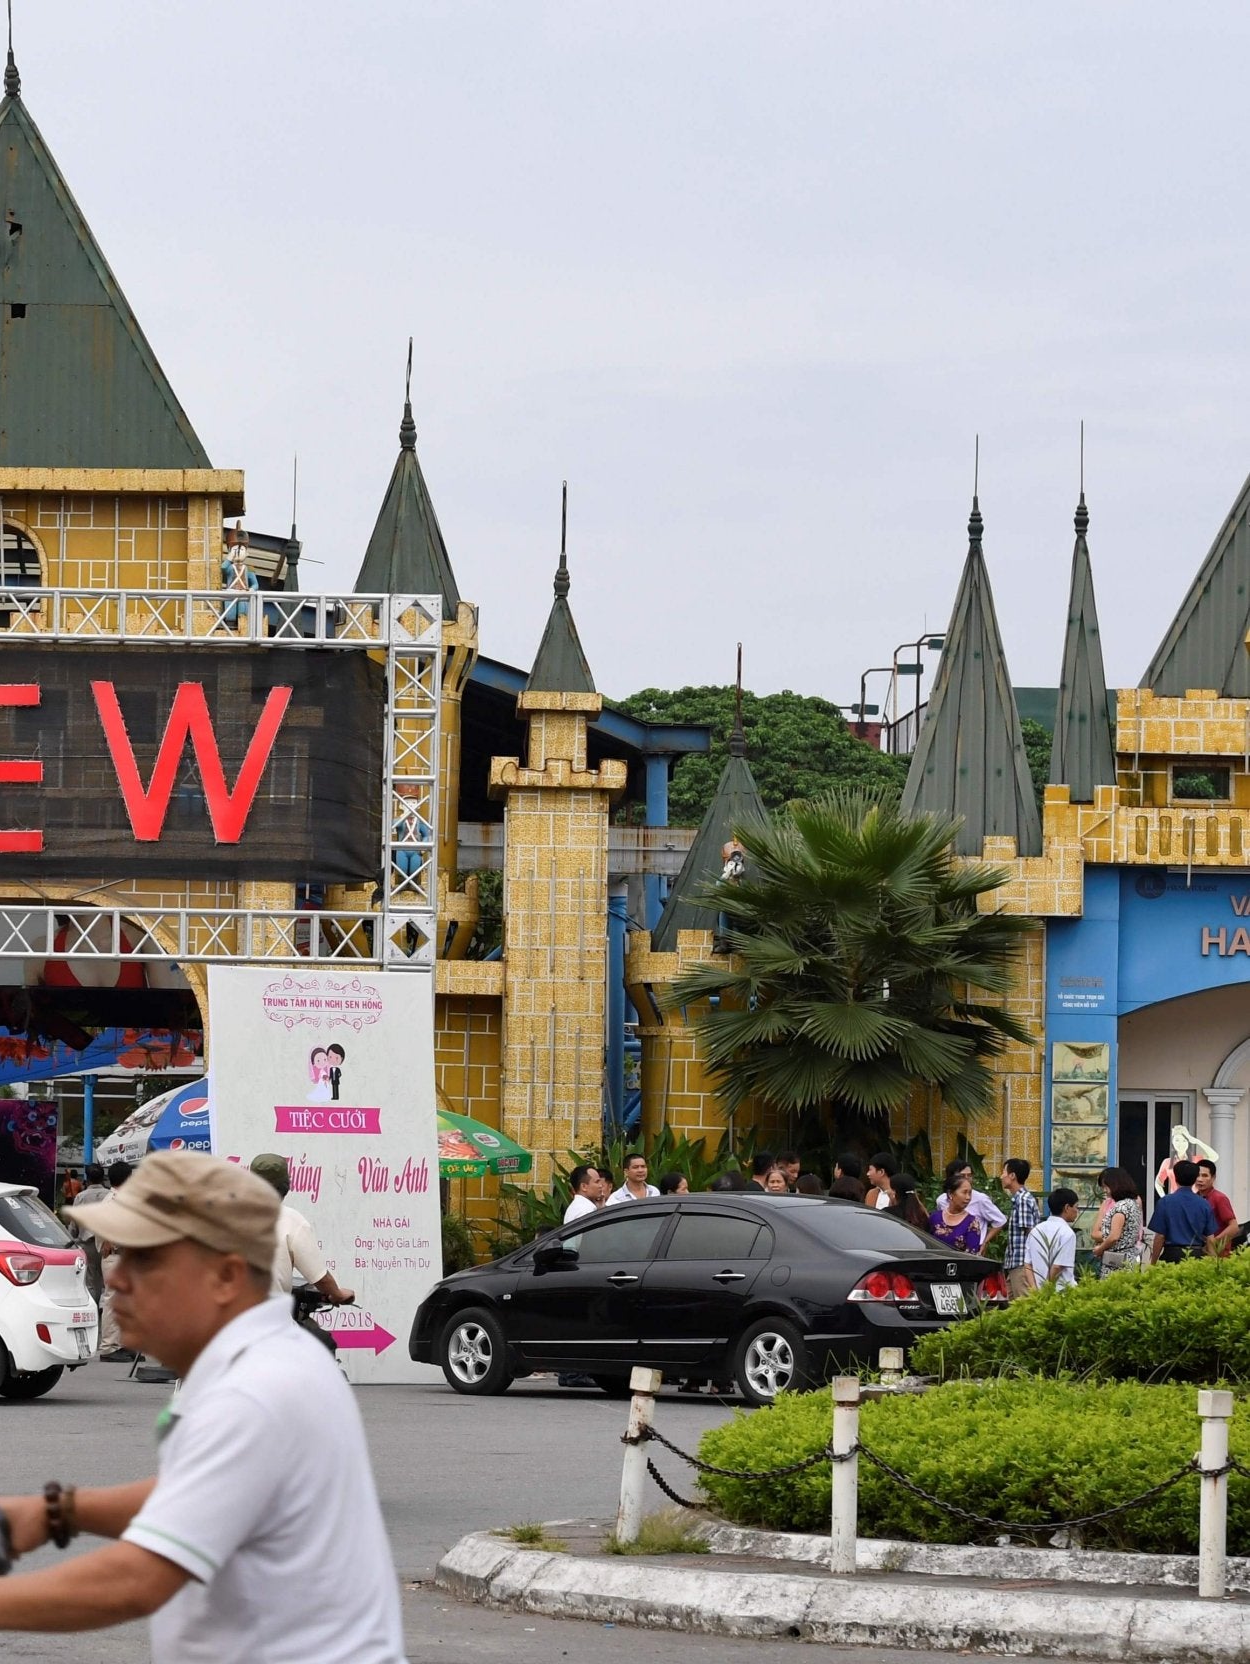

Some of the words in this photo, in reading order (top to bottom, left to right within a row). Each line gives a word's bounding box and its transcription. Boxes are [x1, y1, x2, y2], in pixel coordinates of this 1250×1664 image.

[263, 997, 288, 1007] TRUNG
[291, 997, 307, 1008] TÂM
[345, 1000, 359, 1009] SEN
[289, 1109, 324, 1130] TIỆC
[328, 1110, 366, 1129] CƯỚI
[285, 1153, 322, 1203] hắng
[358, 1156, 389, 1194] Vân
[393, 1156, 430, 1194] Anh
[372, 1216, 392, 1228] NHÀ
[394, 1216, 410, 1228] GÁI
[354, 1236, 375, 1250] Ông:
[396, 1238, 410, 1248] Gia
[412, 1238, 430, 1248] Lâm
[354, 1258, 369, 1268] Bà:
[371, 1256, 402, 1270] Nguyễn
[404, 1257, 417, 1270] Thị
